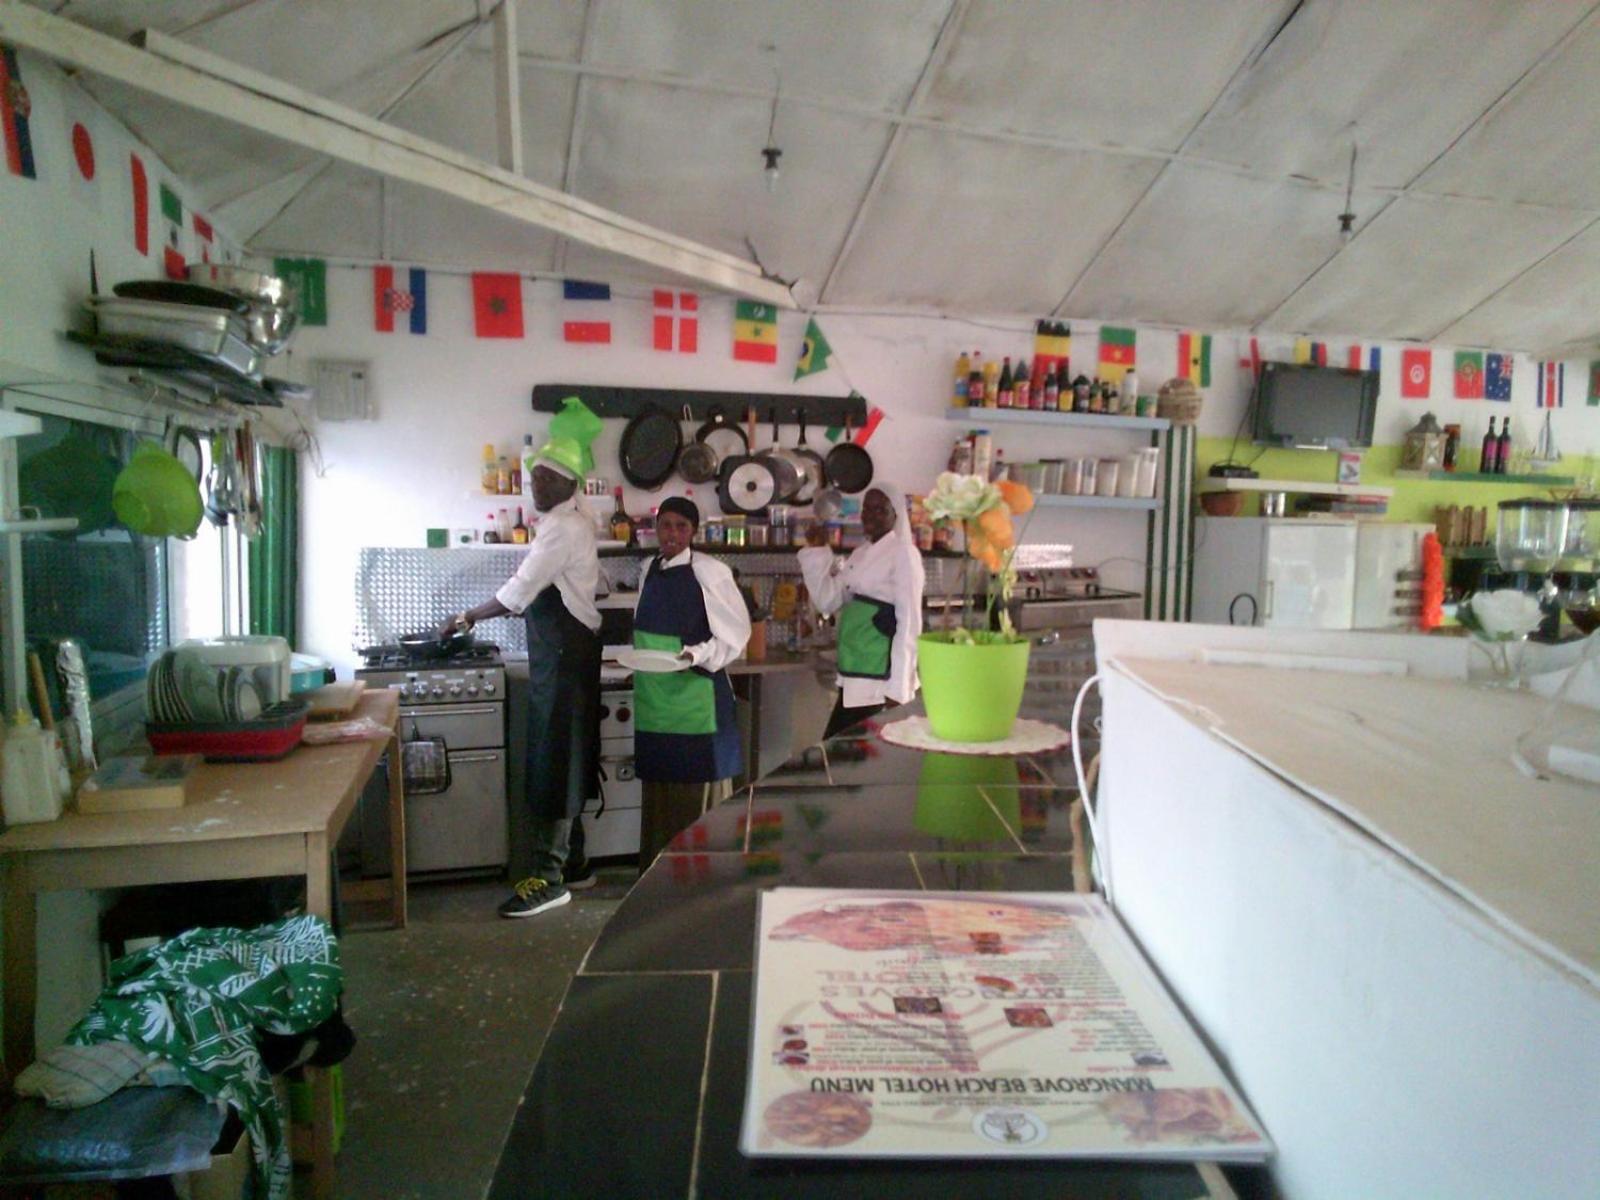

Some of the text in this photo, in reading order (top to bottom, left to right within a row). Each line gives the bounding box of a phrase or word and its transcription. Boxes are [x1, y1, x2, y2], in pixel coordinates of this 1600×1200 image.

[810, 1078, 1154, 1093] MANGROVE BEACH HOTEL MENU
